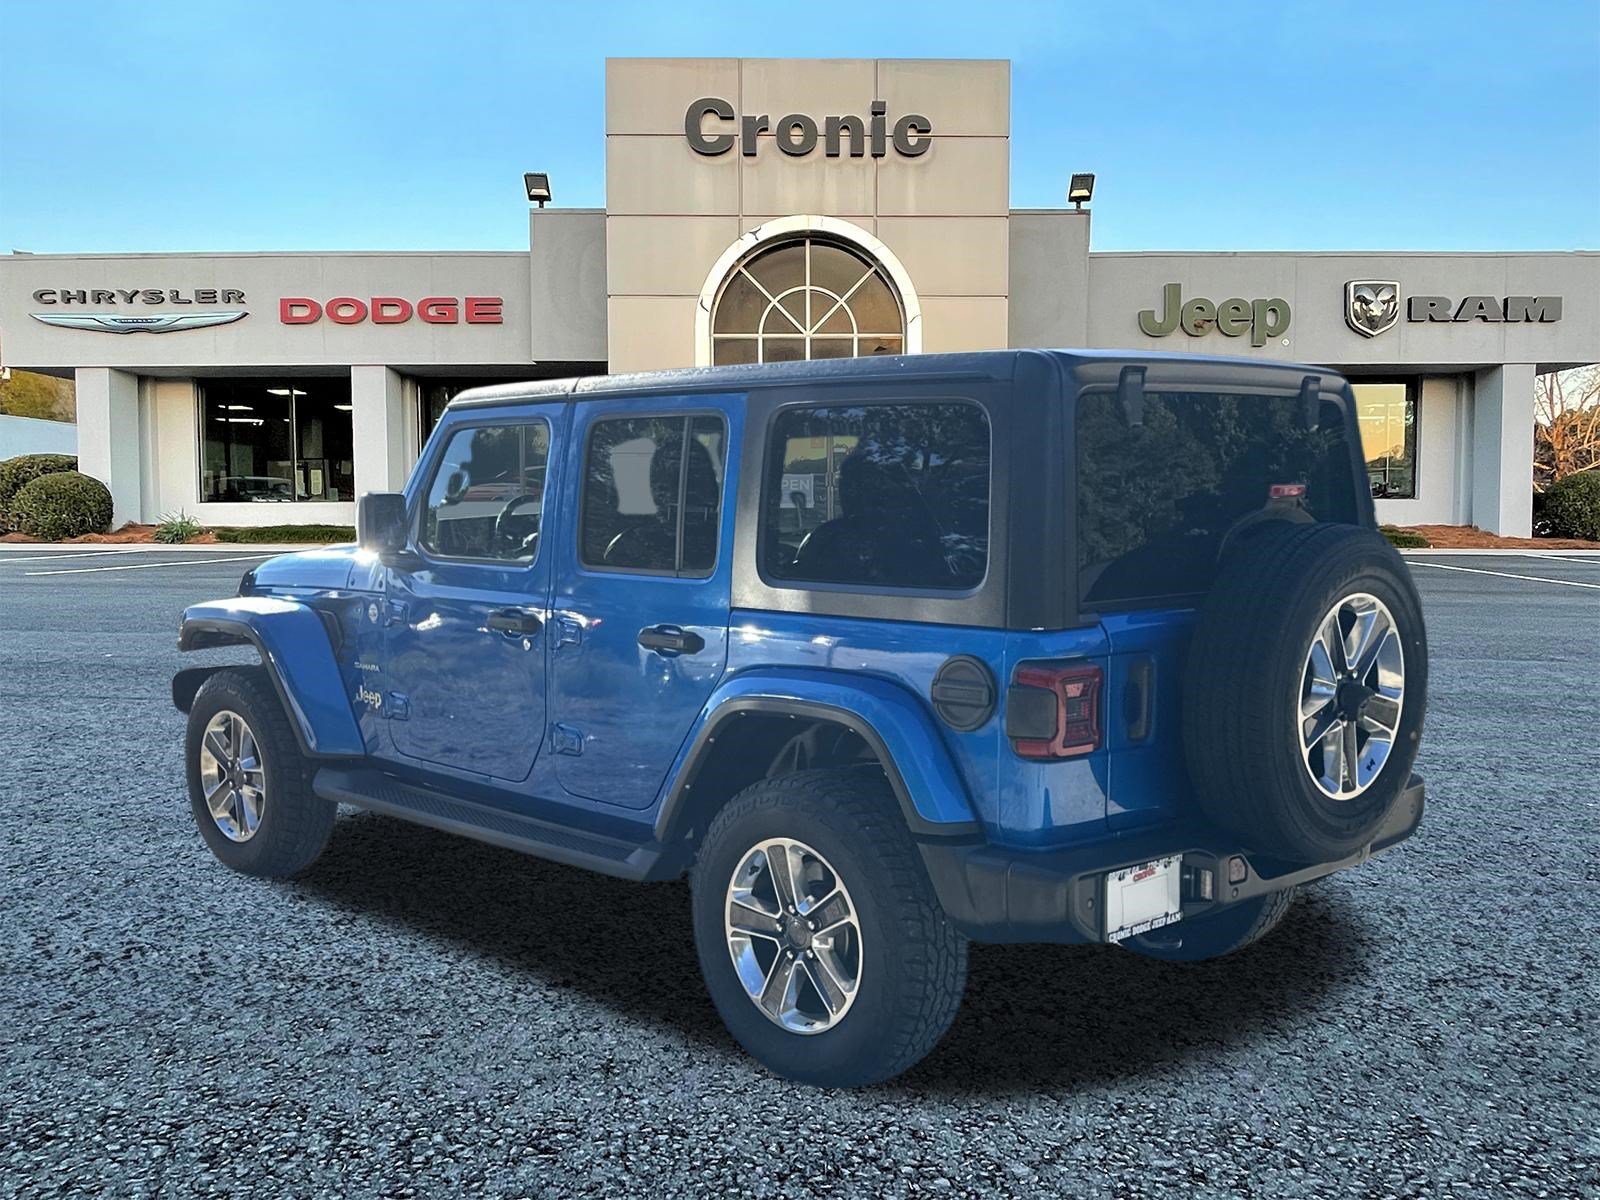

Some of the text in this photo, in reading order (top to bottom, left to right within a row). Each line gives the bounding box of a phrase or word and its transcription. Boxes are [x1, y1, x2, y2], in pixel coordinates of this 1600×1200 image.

[684, 97, 932, 157] Cronic
[32, 288, 246, 304] CHRYSLER
[1407, 296, 1563, 322] RAM
[279, 297, 503, 324] DODGE
[1138, 283, 1291, 347] Jeep
[782, 479, 810, 490] PEN
[355, 685, 382, 709] Jeep
